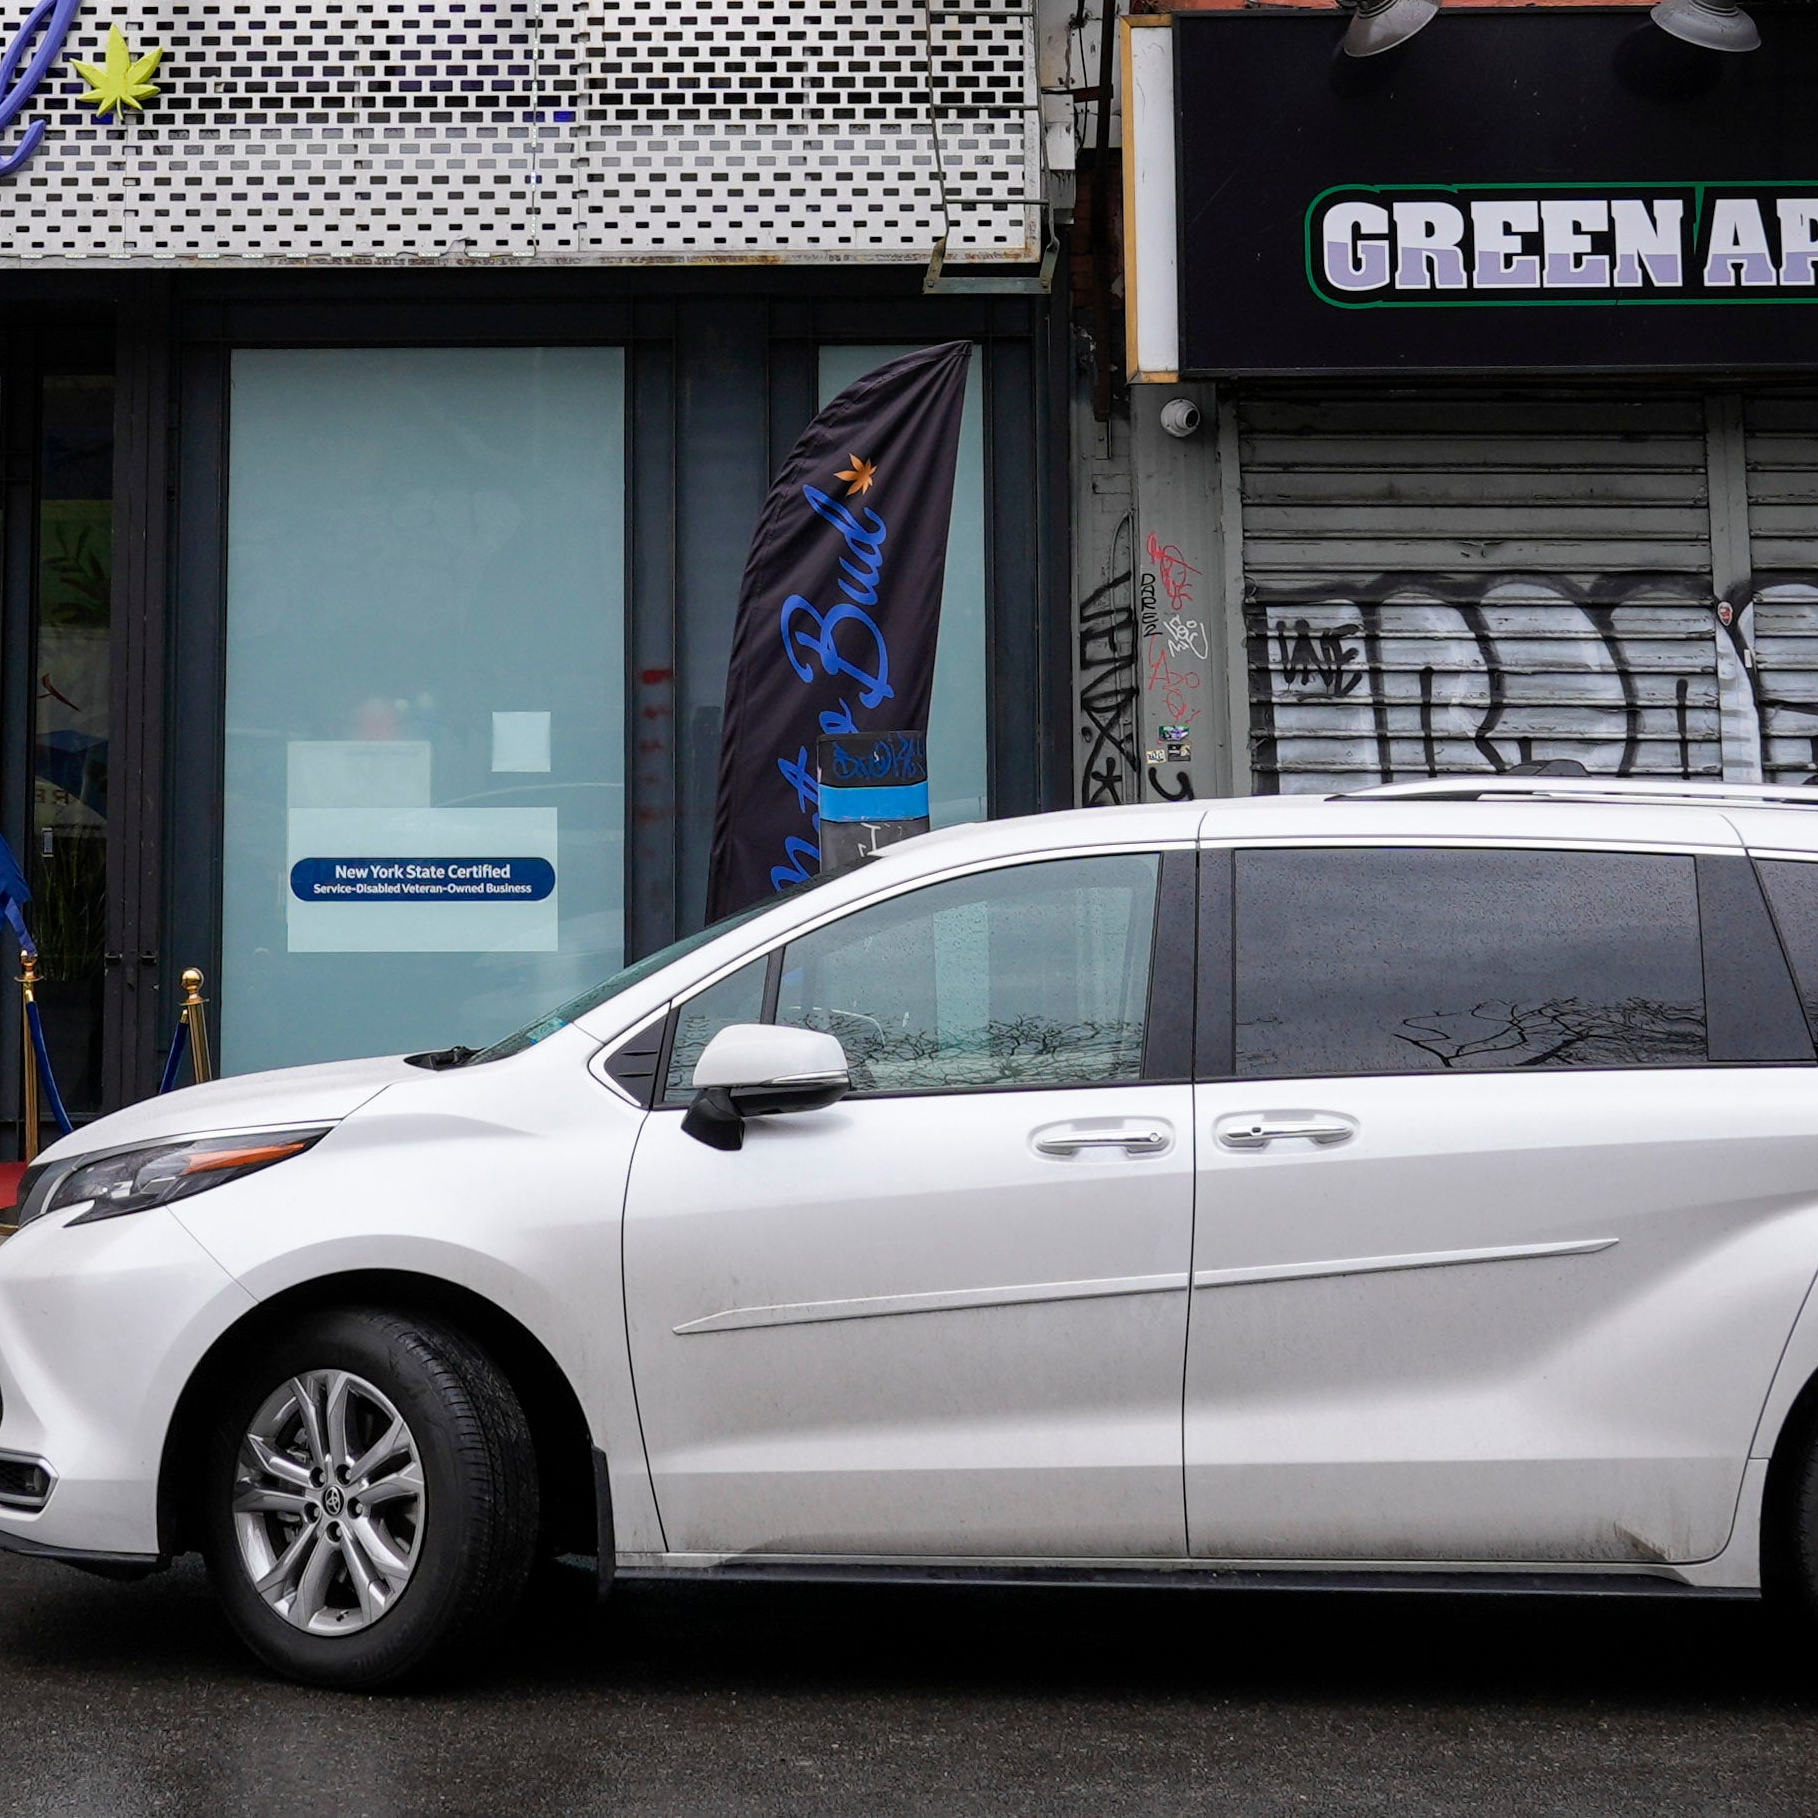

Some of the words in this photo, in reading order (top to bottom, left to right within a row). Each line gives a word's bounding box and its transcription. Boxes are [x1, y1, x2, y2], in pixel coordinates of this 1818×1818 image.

[1322, 197, 1686, 291] GREEN
[780, 483, 895, 709] Bud
[313, 883, 401, 895] Service-Disabled
[401, 883, 485, 895] Veteran-Owned
[486, 883, 532, 895] Business
[335, 865, 370, 879] New
[372, 865, 404, 879] York
[406, 865, 446, 879] State
[447, 864, 511, 879] Certified
